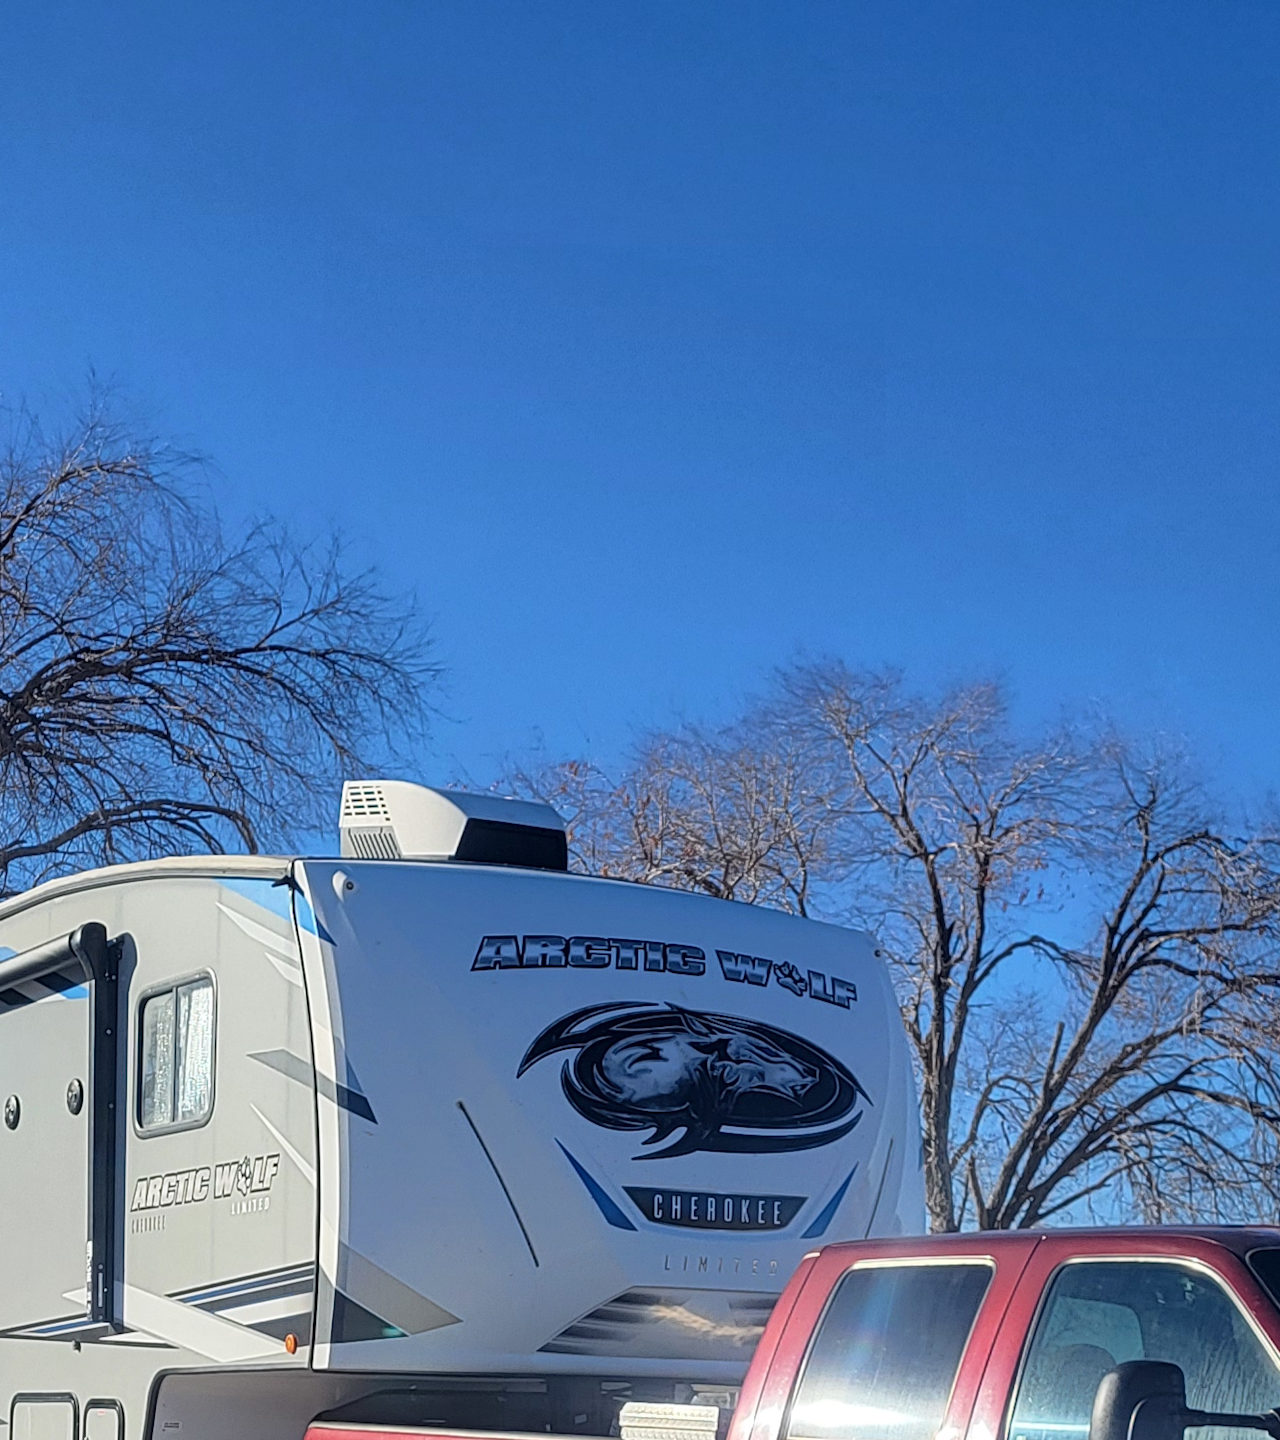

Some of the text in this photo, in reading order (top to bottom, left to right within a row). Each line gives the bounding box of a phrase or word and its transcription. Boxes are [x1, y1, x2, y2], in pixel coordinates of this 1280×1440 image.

[471, 935, 706, 976] ARCTIC
[130, 1166, 211, 1212] ARCTIC
[231, 1197, 270, 1215] LIMITED
[653, 1194, 783, 1225] CHEROKEE
[664, 1255, 778, 1276] LIMITED
